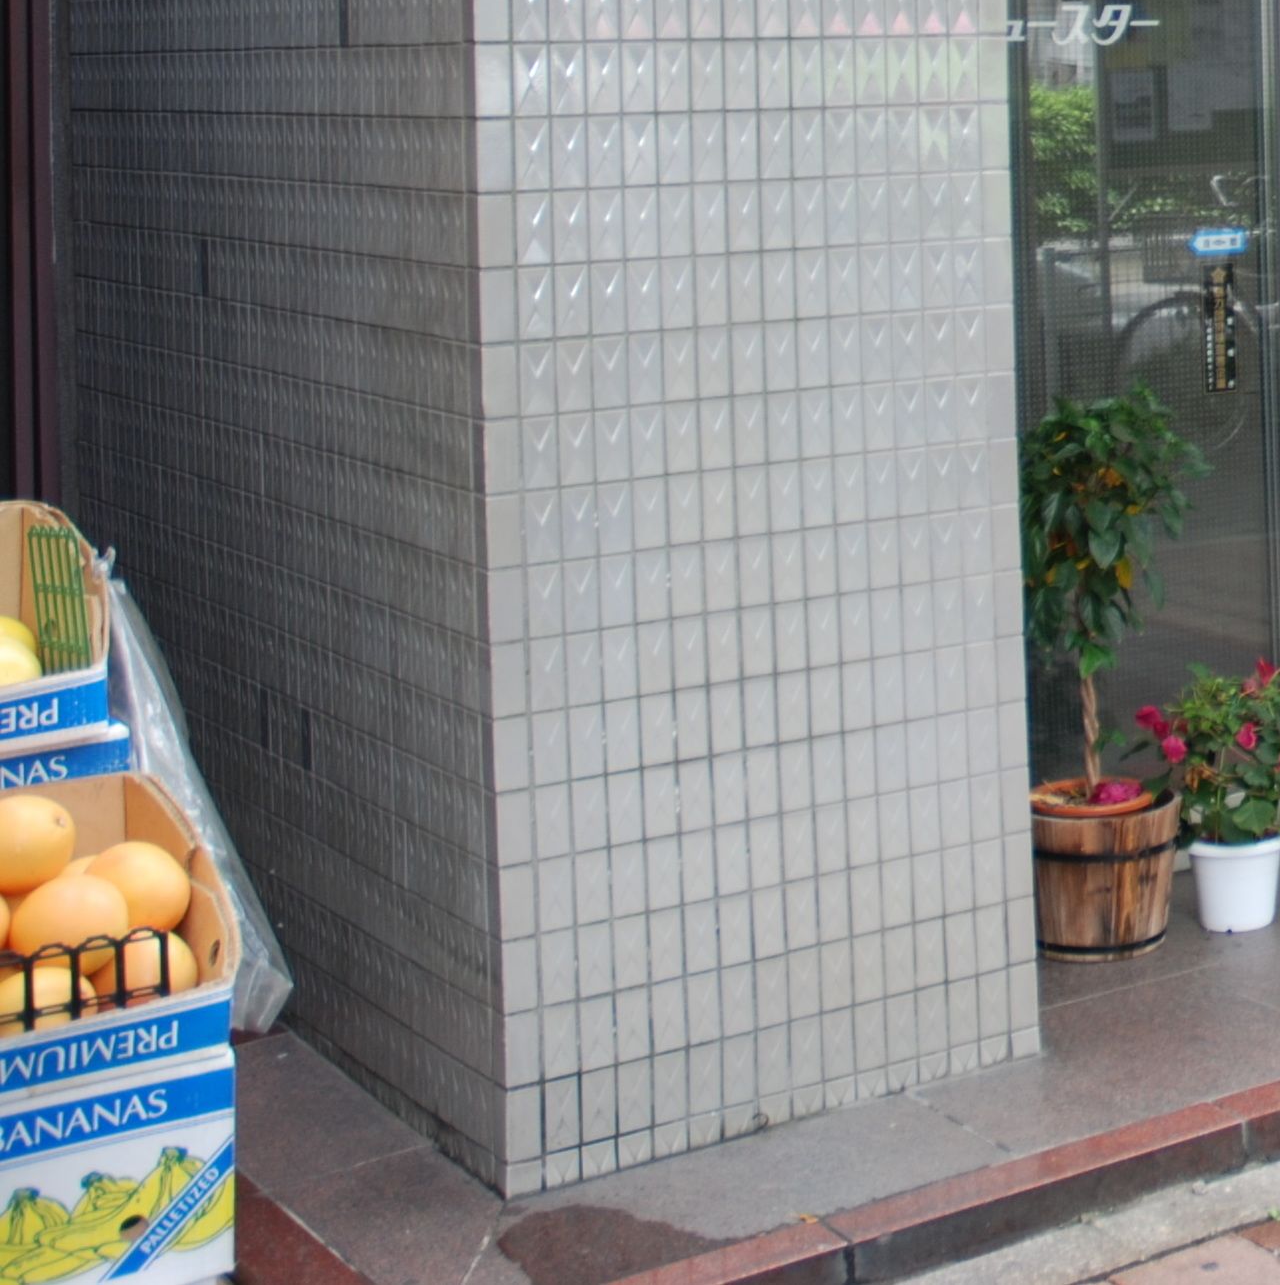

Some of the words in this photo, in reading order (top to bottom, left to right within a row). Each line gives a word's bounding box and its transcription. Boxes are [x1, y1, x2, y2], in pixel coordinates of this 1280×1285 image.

[0, 1020, 179, 1085] PREMIUM
[0, 1089, 167, 1152] ANANAS
[140, 1167, 219, 1254] PALLETIZED
